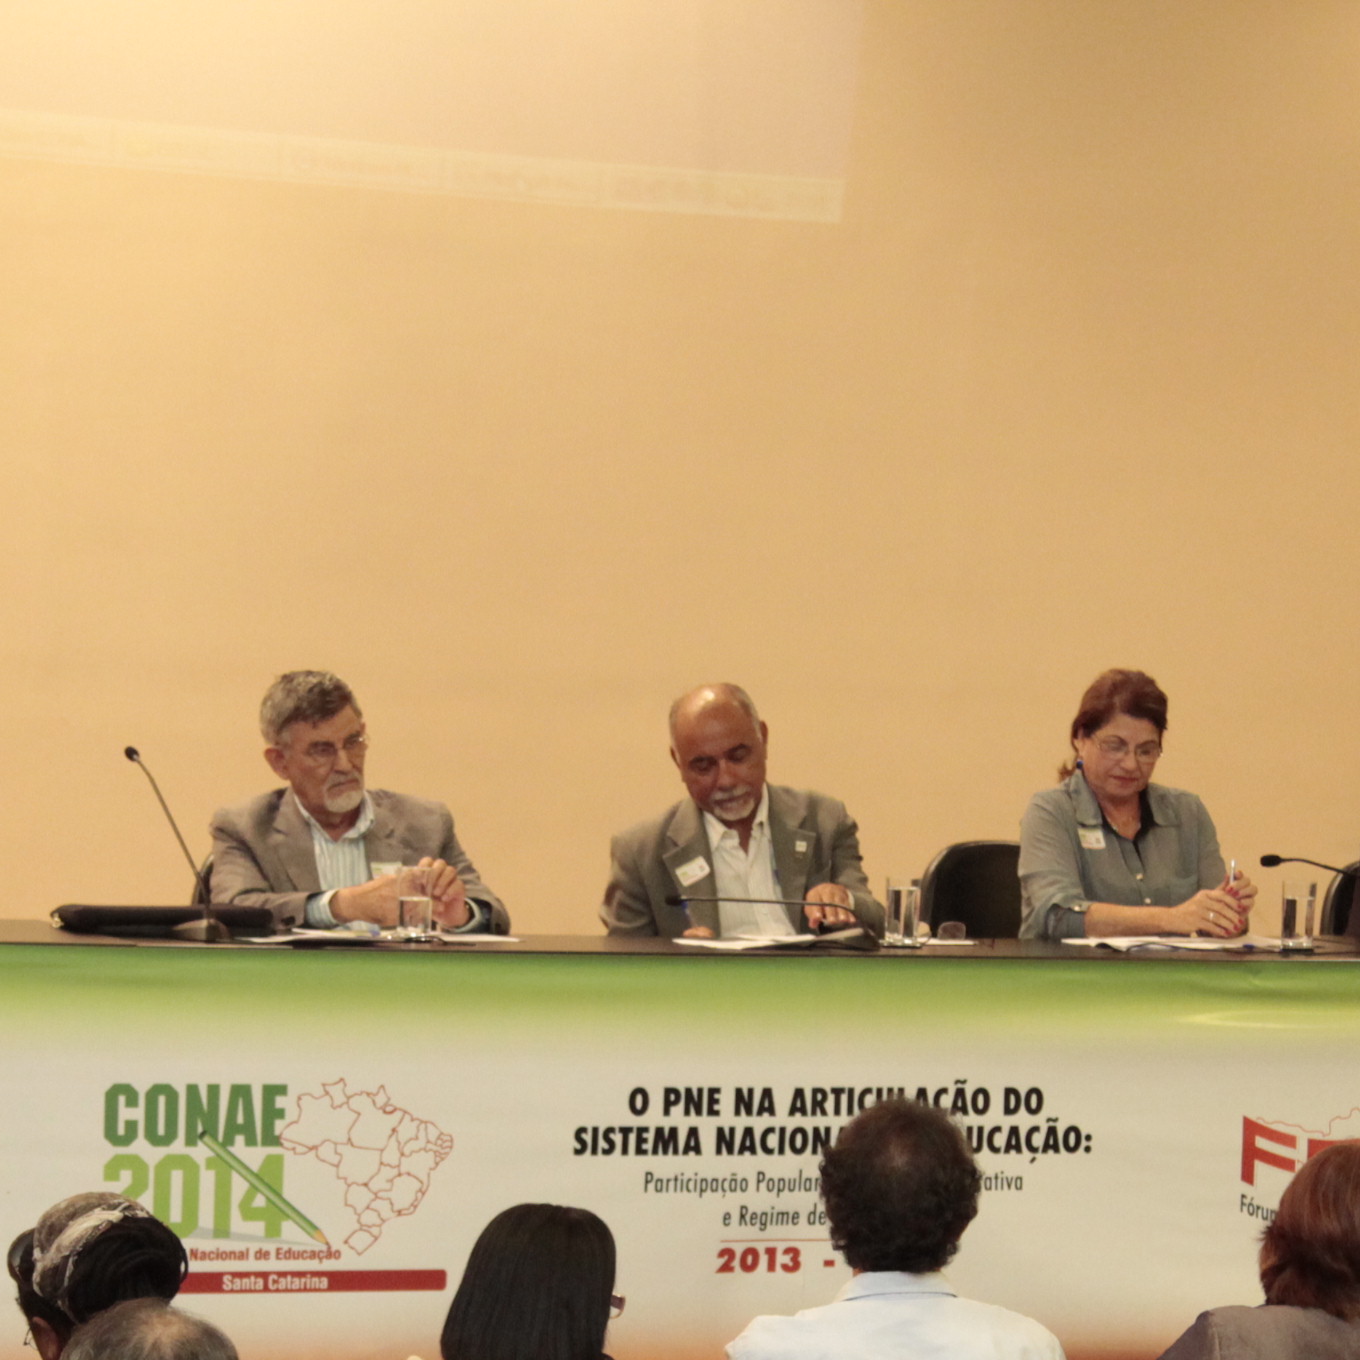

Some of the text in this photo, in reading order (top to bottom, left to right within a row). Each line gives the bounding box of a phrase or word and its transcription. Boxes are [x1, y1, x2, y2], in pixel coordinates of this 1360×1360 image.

[104, 1083, 288, 1147] CONAE
[629, 1087, 650, 1117] O
[663, 1087, 721, 1117] PNE
[734, 1087, 776, 1117] NA
[1003, 1087, 1044, 1116] DO
[573, 1117, 1093, 1164] SISTEMA NACION UCAÇÃO:
[644, 1171, 748, 1198] Participação
[981, 1171, 1023, 1191] ativa
[723, 1204, 827, 1232] e Regime de
[189, 1246, 342, 1265] Nacional de Educação
[715, 1247, 802, 1273] 2013
[222, 1272, 328, 1292] Santa Catarina
